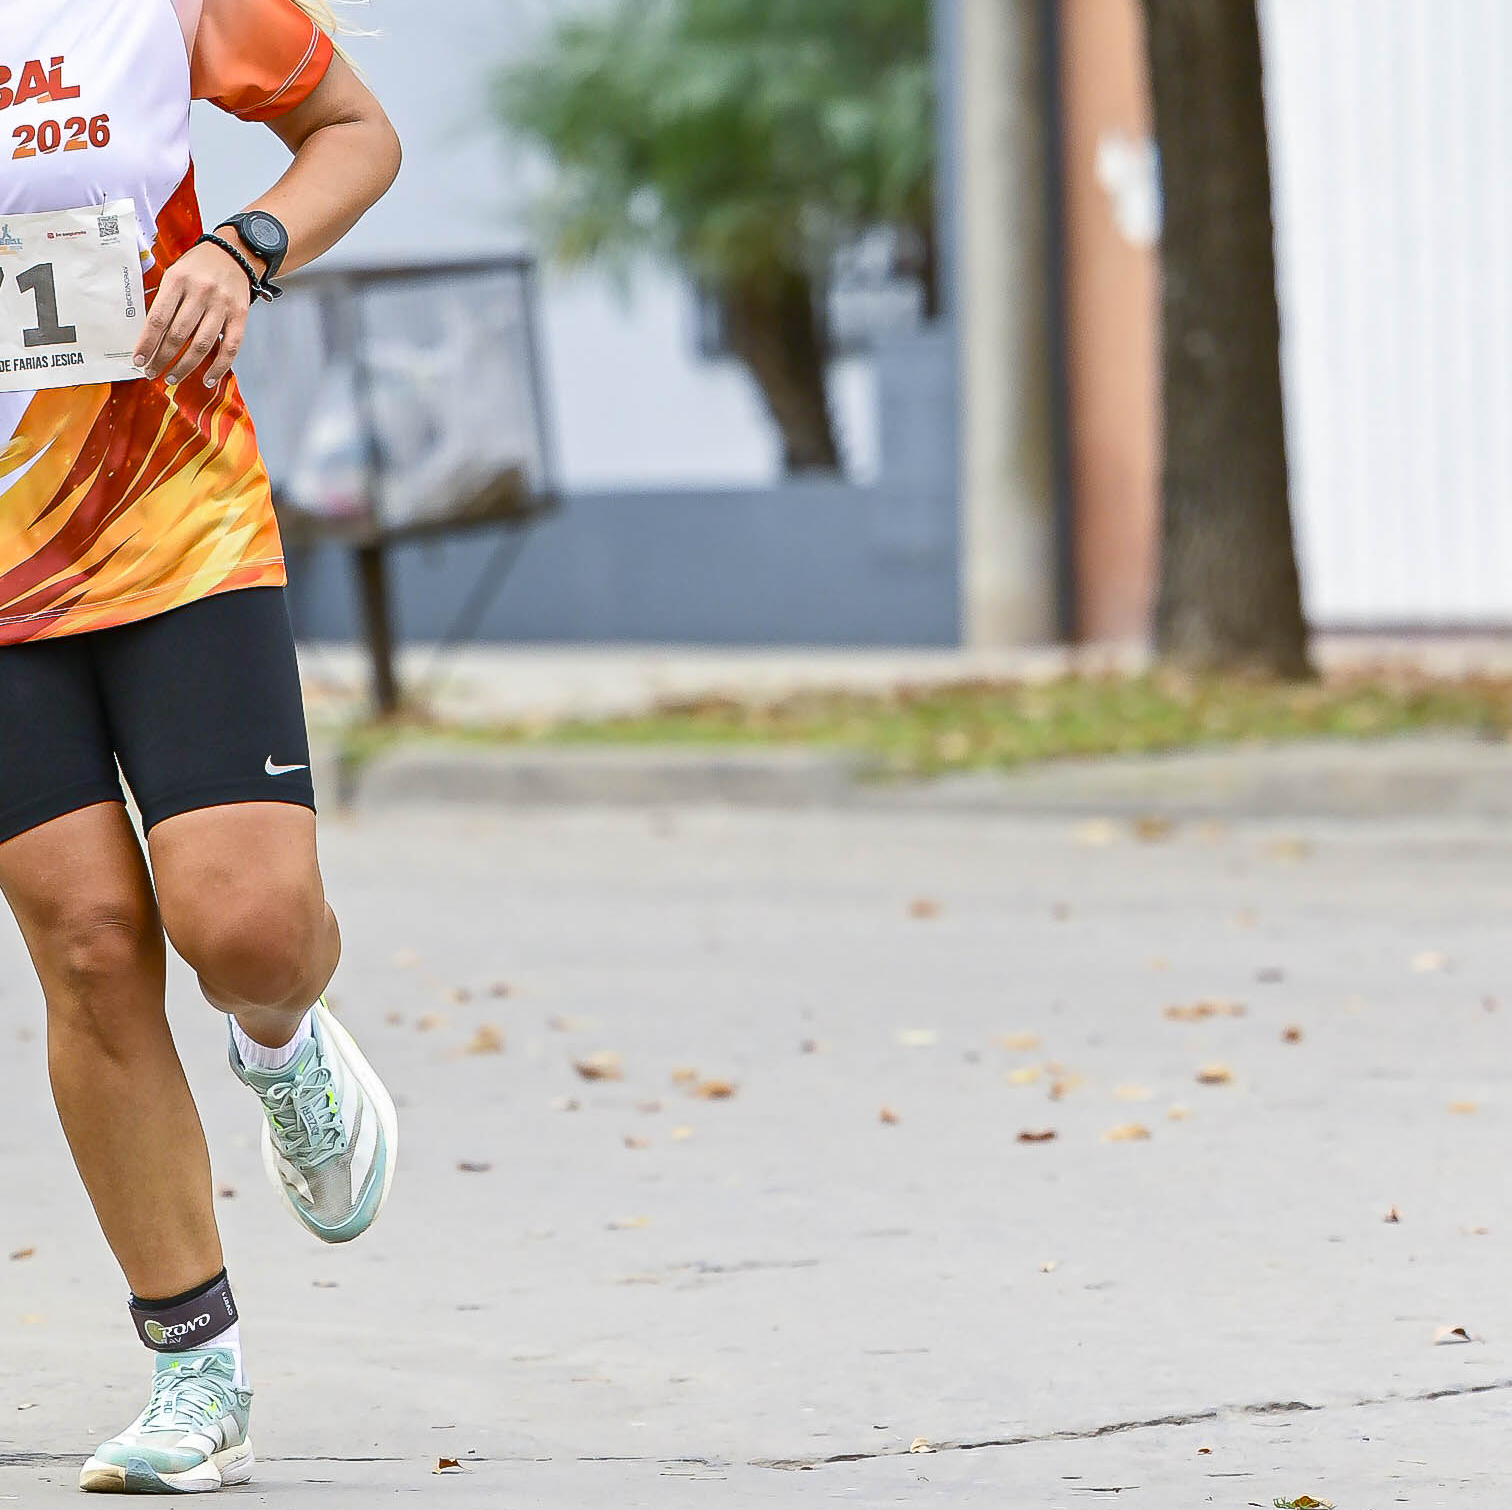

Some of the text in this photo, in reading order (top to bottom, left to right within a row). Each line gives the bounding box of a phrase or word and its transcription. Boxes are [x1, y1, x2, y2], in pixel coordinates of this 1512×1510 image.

[11, 113, 110, 160] 2026
[13, 355, 48, 371] FARIAS
[50, 352, 85, 367] JESICA
